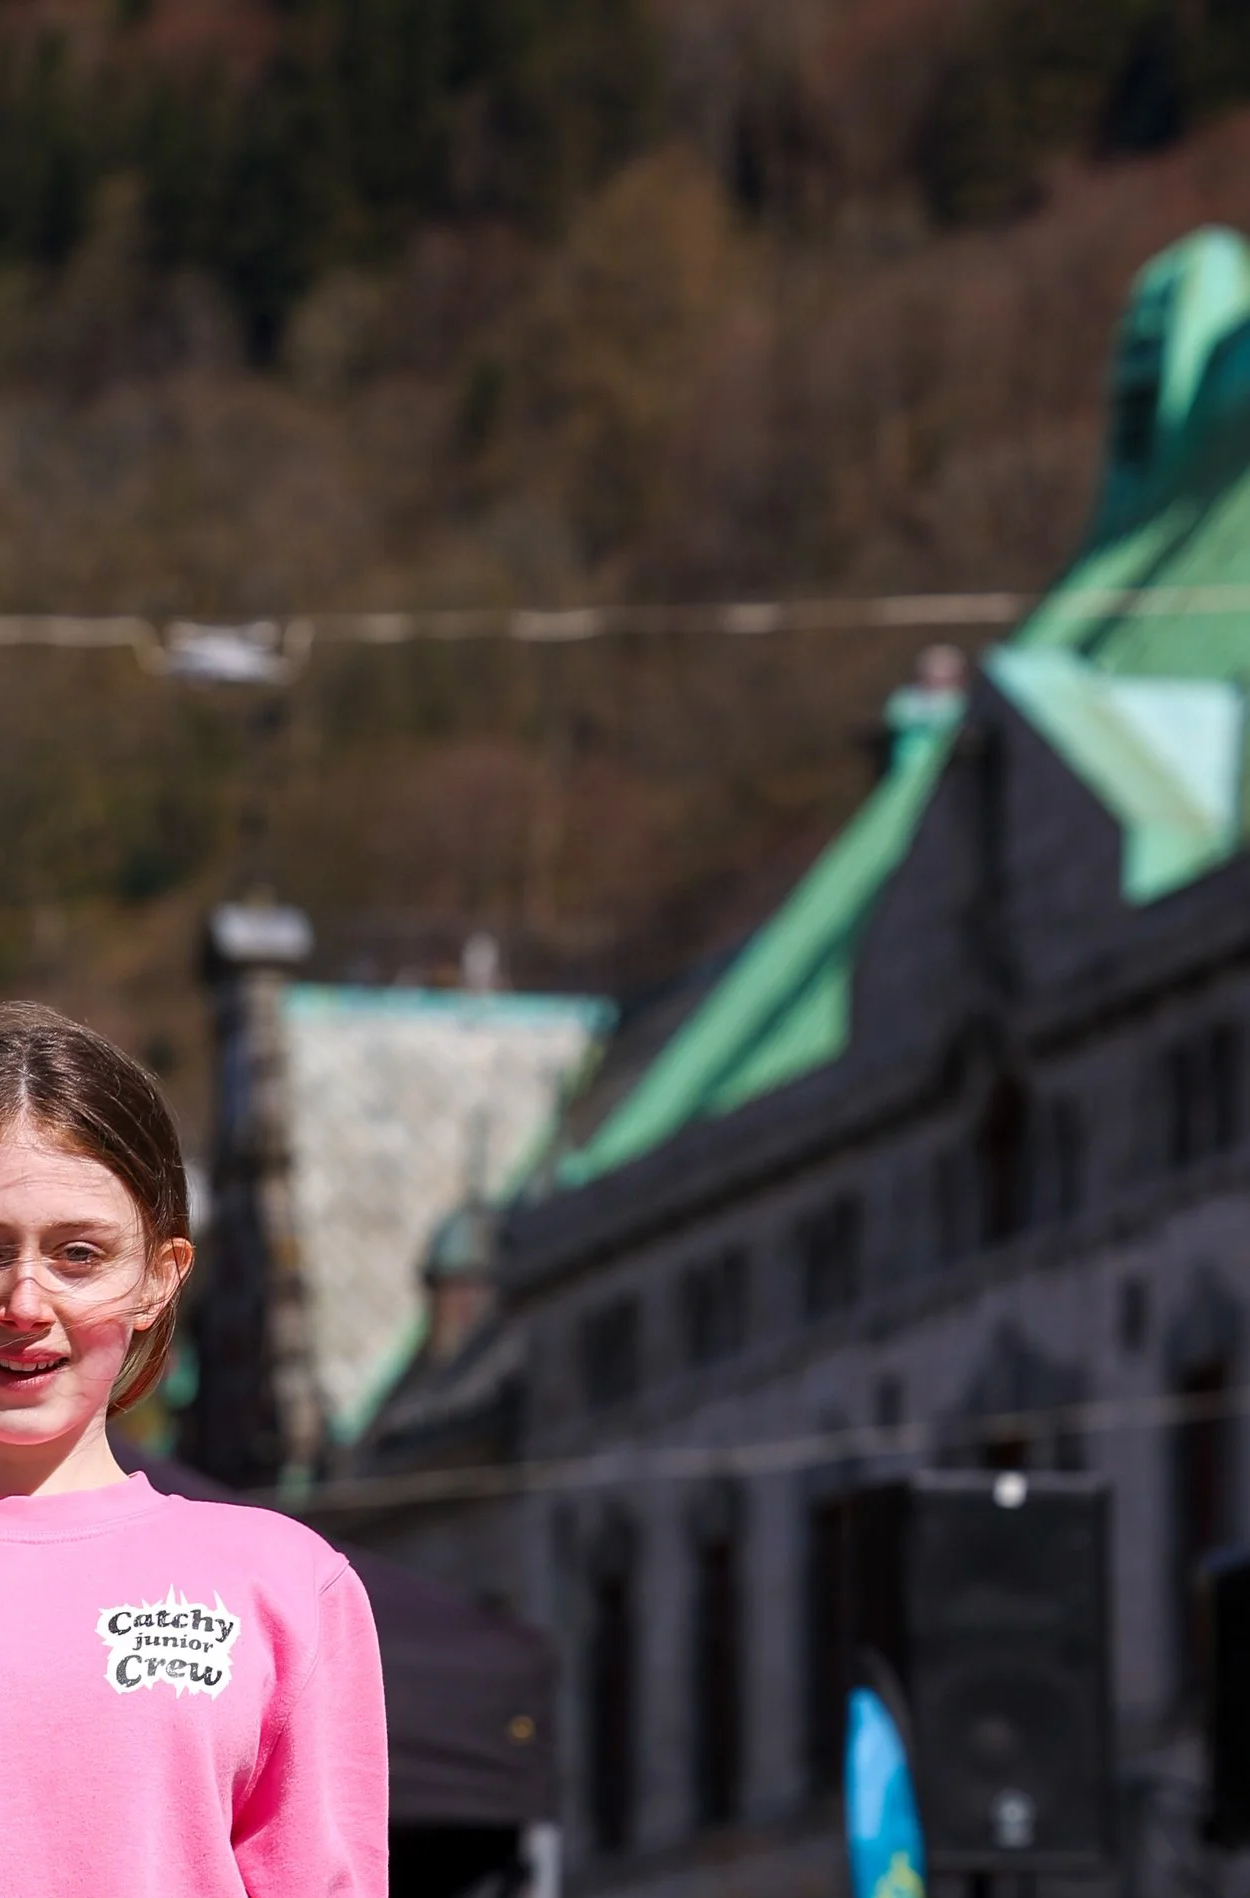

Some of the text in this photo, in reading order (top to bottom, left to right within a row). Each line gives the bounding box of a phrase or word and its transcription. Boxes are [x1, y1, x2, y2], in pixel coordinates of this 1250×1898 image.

[107, 1609, 234, 1643] Catchy
[132, 1632, 214, 1653] junior
[115, 1654, 223, 1688] Crew
